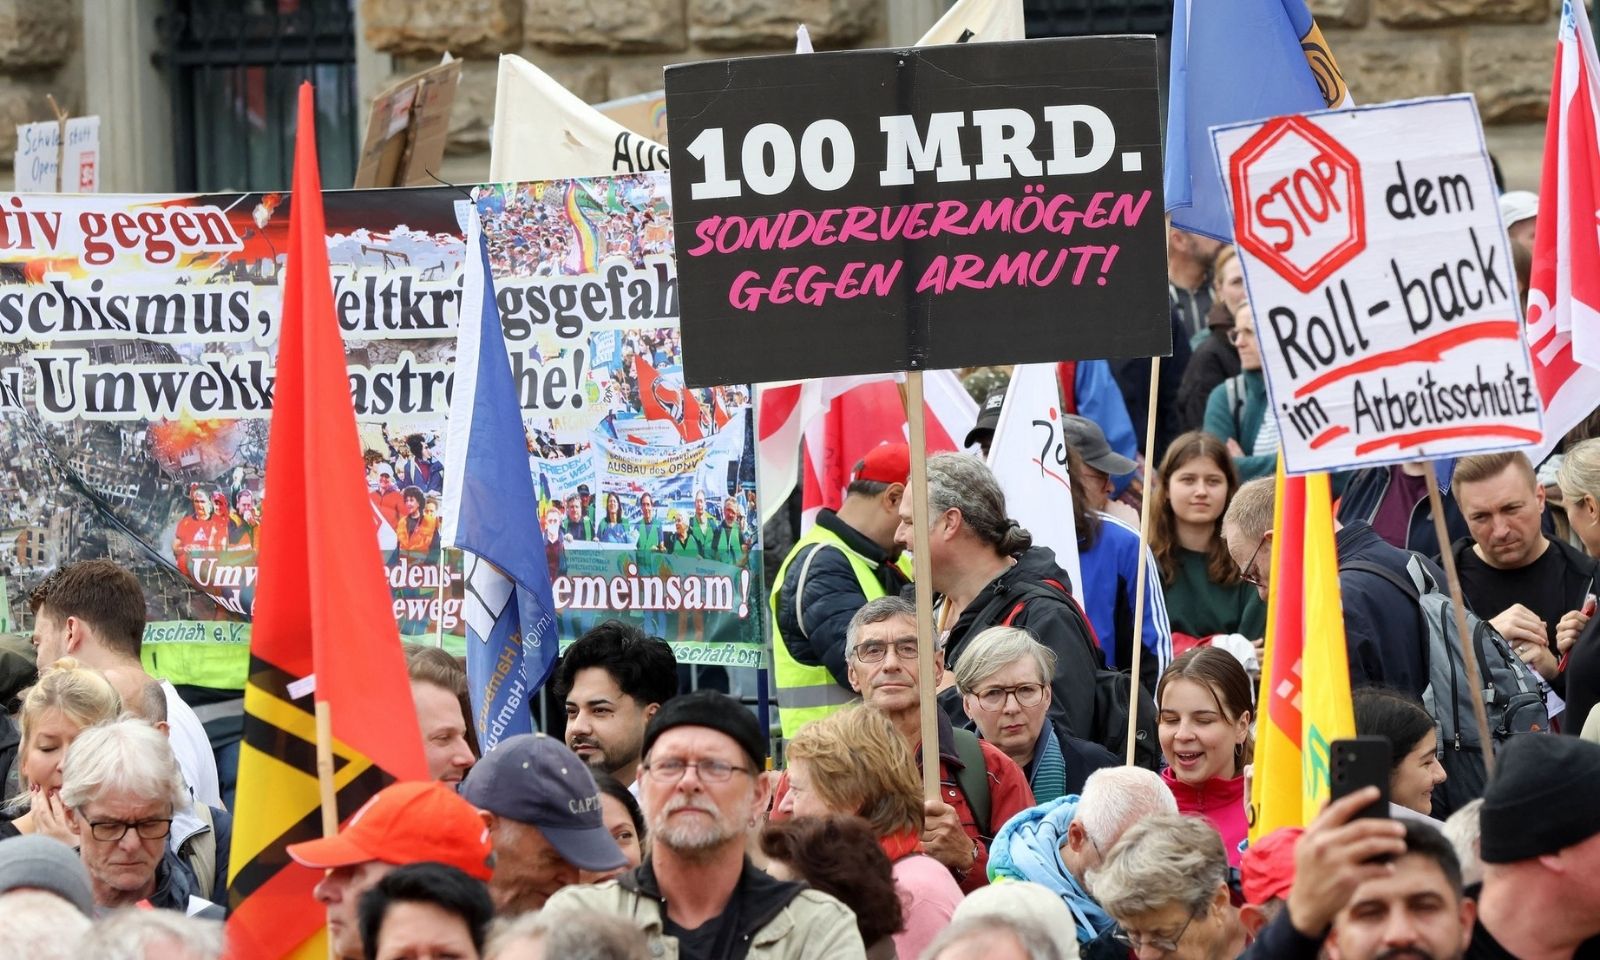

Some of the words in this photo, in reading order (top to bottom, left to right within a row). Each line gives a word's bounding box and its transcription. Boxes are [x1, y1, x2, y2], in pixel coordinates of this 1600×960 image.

[687, 118, 856, 200] 100
[879, 104, 1143, 187] MRD.
[687, 185, 1152, 257] SONDERVERMÖGEN
[1255, 152, 1342, 253] STOP
[1385, 160, 1475, 220] dem
[79, 208, 238, 265] gegen
[728, 259, 904, 311] GEGEN
[916, 245, 1120, 295] ARMUT!
[1268, 227, 1508, 380] Roll-back
[1282, 394, 1330, 440] im
[1352, 363, 1537, 435] Arbeitsschutz
[607, 460, 647, 475] AUSBAU
[551, 563, 750, 618] emeinsam!
[143, 622, 206, 642] kschaft
[213, 623, 245, 642] e.V.
[673, 643, 762, 668] kschaft.org
